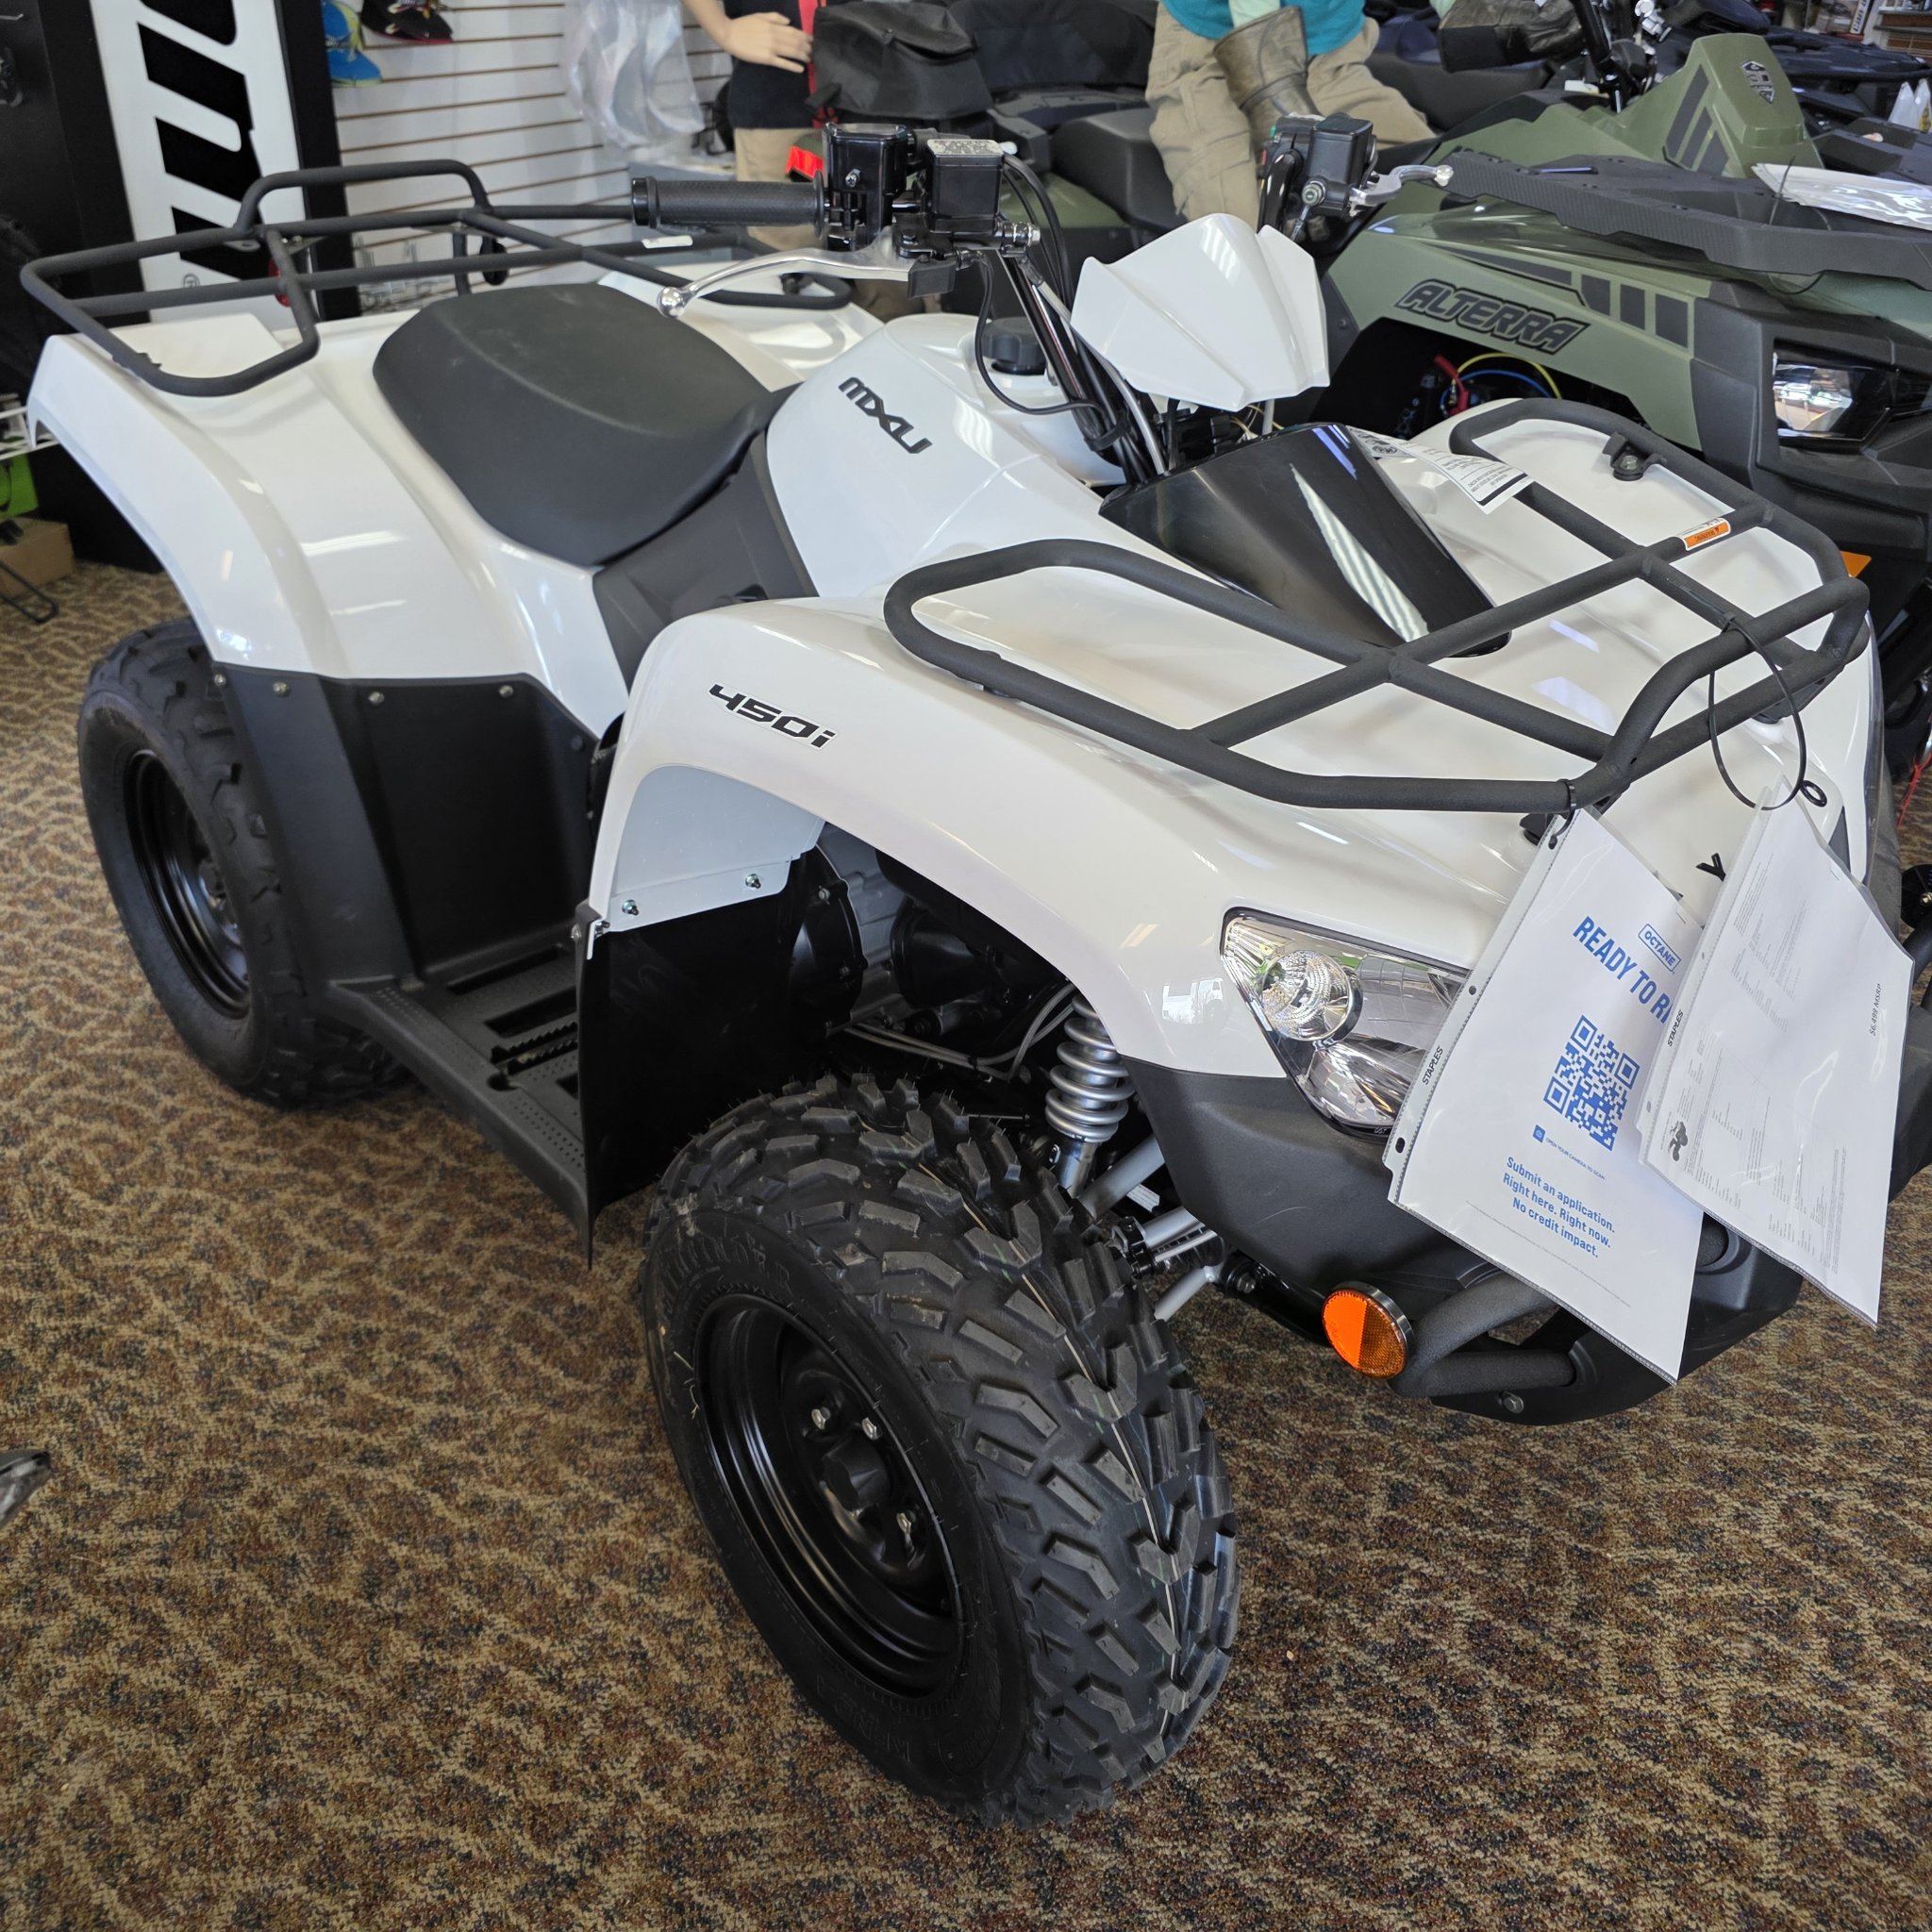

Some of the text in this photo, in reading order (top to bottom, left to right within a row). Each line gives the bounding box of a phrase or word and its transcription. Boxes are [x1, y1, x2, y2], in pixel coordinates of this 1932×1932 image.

[1401, 281, 1581, 350] ALTERRA
[709, 684, 836, 748] 450i
[1573, 916, 1638, 980] READY
[1629, 970, 1657, 1004] TO
[1644, 930, 1676, 966] OCTANE
[1874, 983, 1882, 1008] MSRP
[1668, 1009, 1683, 1047] STAPLES
[1423, 1045, 1443, 1085] STAPLES
[1503, 1173, 1529, 1198] Right
[1531, 1191, 1557, 1215] here.
[1559, 1208, 1587, 1232] Right
[1589, 1227, 1611, 1248] now.
[1507, 1157, 1615, 1233] Submit an application.
[1512, 1197, 1526, 1213] No
[1528, 1208, 1559, 1233] credit
[1560, 1226, 1599, 1257] impact.
